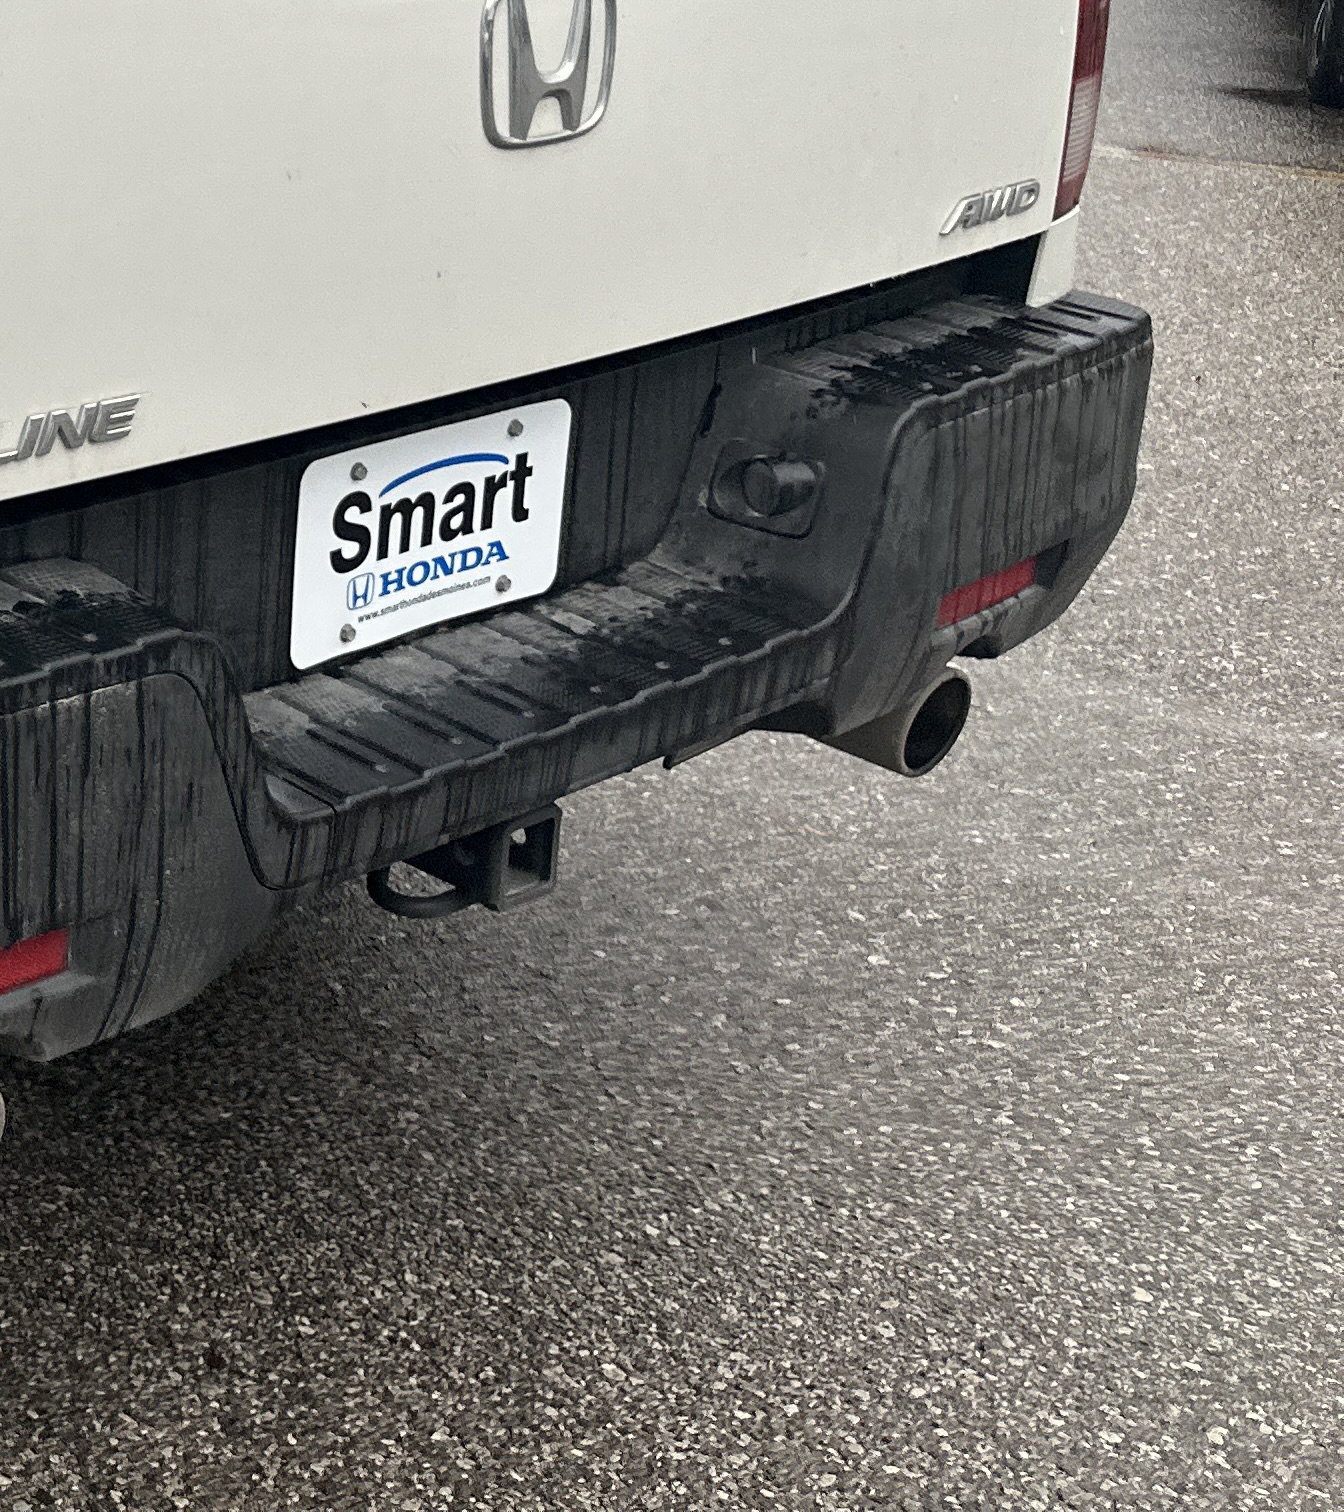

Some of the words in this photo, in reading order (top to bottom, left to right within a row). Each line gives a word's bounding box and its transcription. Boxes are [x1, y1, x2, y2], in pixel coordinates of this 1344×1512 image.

[939, 178, 1040, 236] AWD
[329, 452, 533, 575] Smart
[378, 539, 510, 597] HONDA
